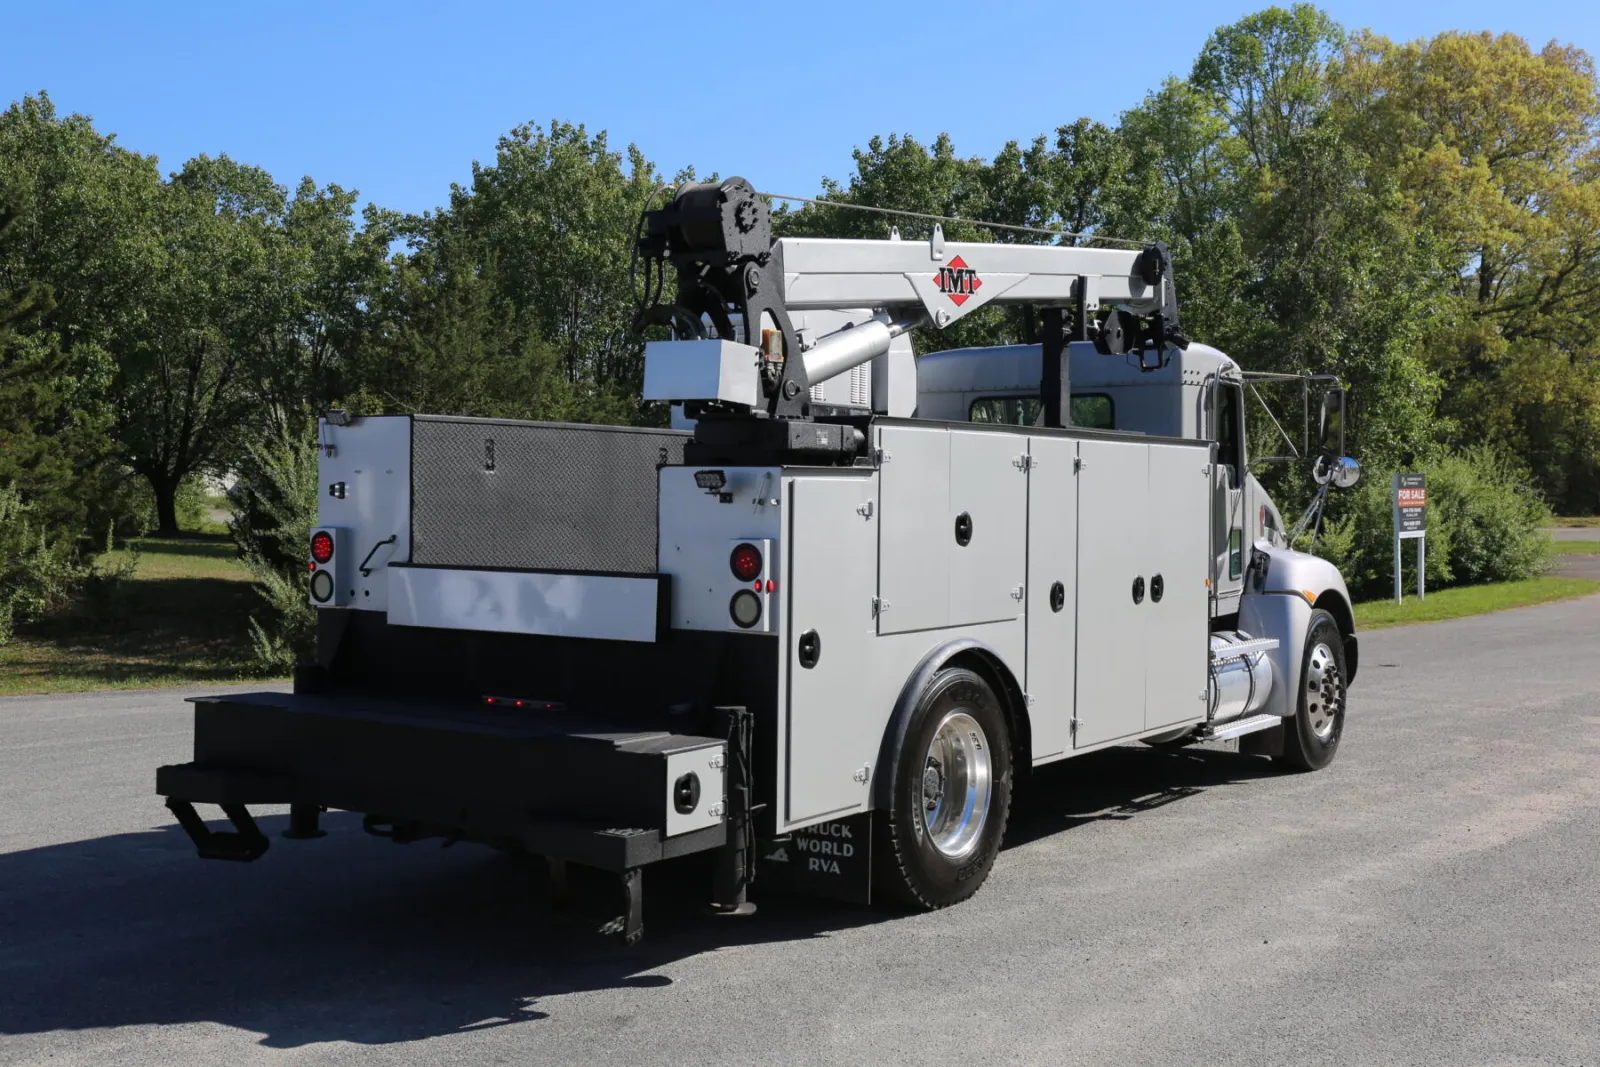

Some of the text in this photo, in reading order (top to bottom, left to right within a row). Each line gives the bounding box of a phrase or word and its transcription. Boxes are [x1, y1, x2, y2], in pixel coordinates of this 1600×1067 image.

[939, 267, 976, 294] IMT
[1398, 489, 1425, 500] FOR SALE
[796, 837, 854, 857] WORLD
[808, 857, 841, 874] RVA
